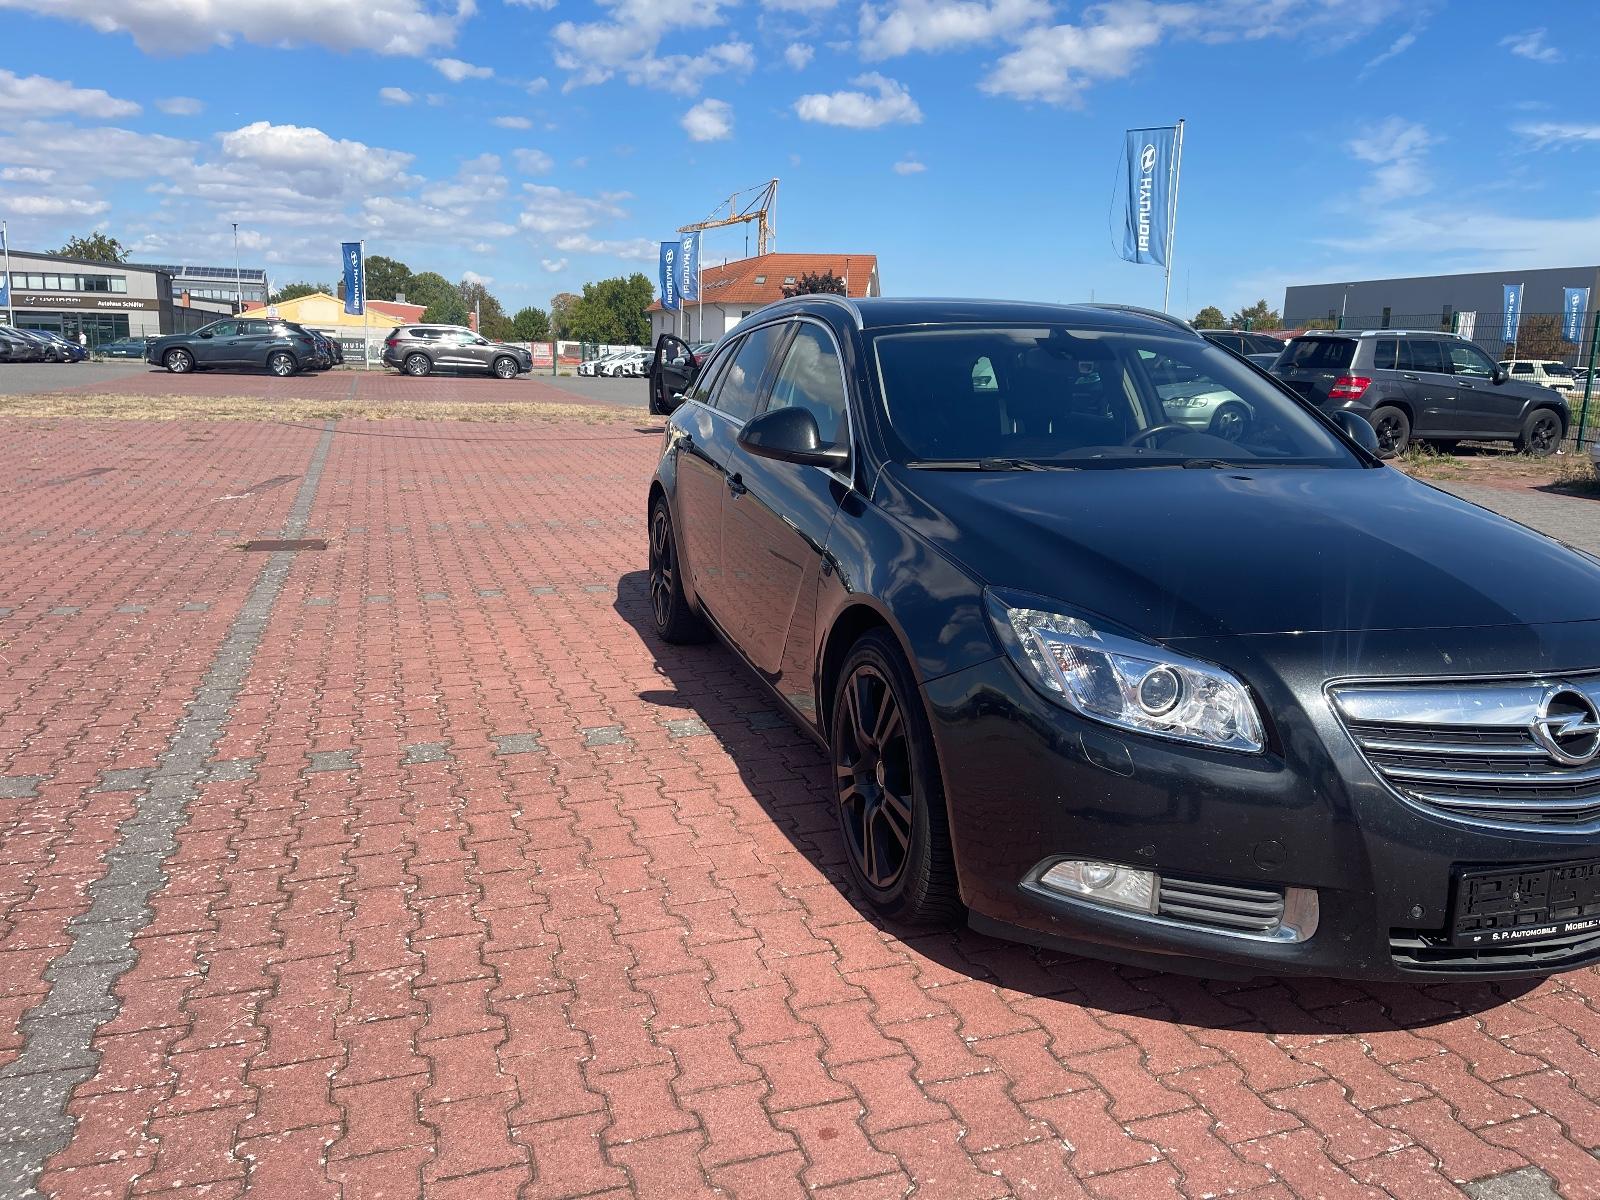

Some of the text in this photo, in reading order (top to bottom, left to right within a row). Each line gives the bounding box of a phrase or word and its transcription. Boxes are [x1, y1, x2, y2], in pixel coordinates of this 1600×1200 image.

[1492, 932, 1500, 940] S.
[1502, 931, 1510, 939] P.
[1510, 926, 1557, 938] AUTOMOBILE
